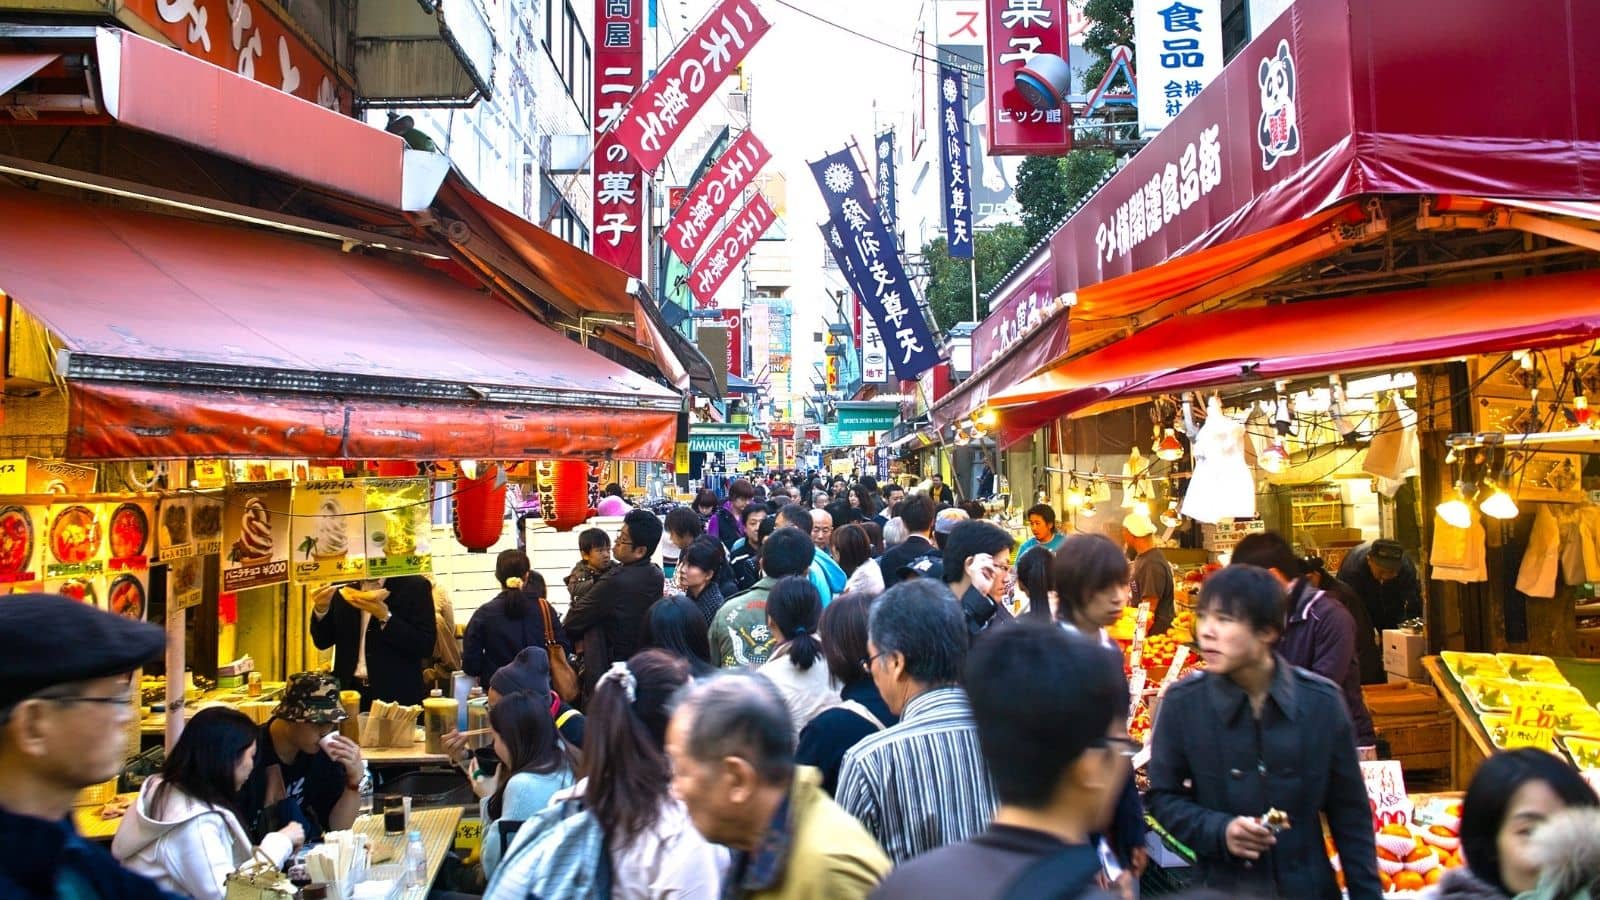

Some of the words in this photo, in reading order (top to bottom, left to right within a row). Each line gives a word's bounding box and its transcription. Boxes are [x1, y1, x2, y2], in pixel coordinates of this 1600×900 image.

[1157, 1, 1204, 69] 食品
[998, 108, 1061, 123] ビック館
[595, 66, 637, 247] 二木の菓子
[225, 566, 261, 579] バニラチョコ
[262, 562, 287, 576] ¥200
